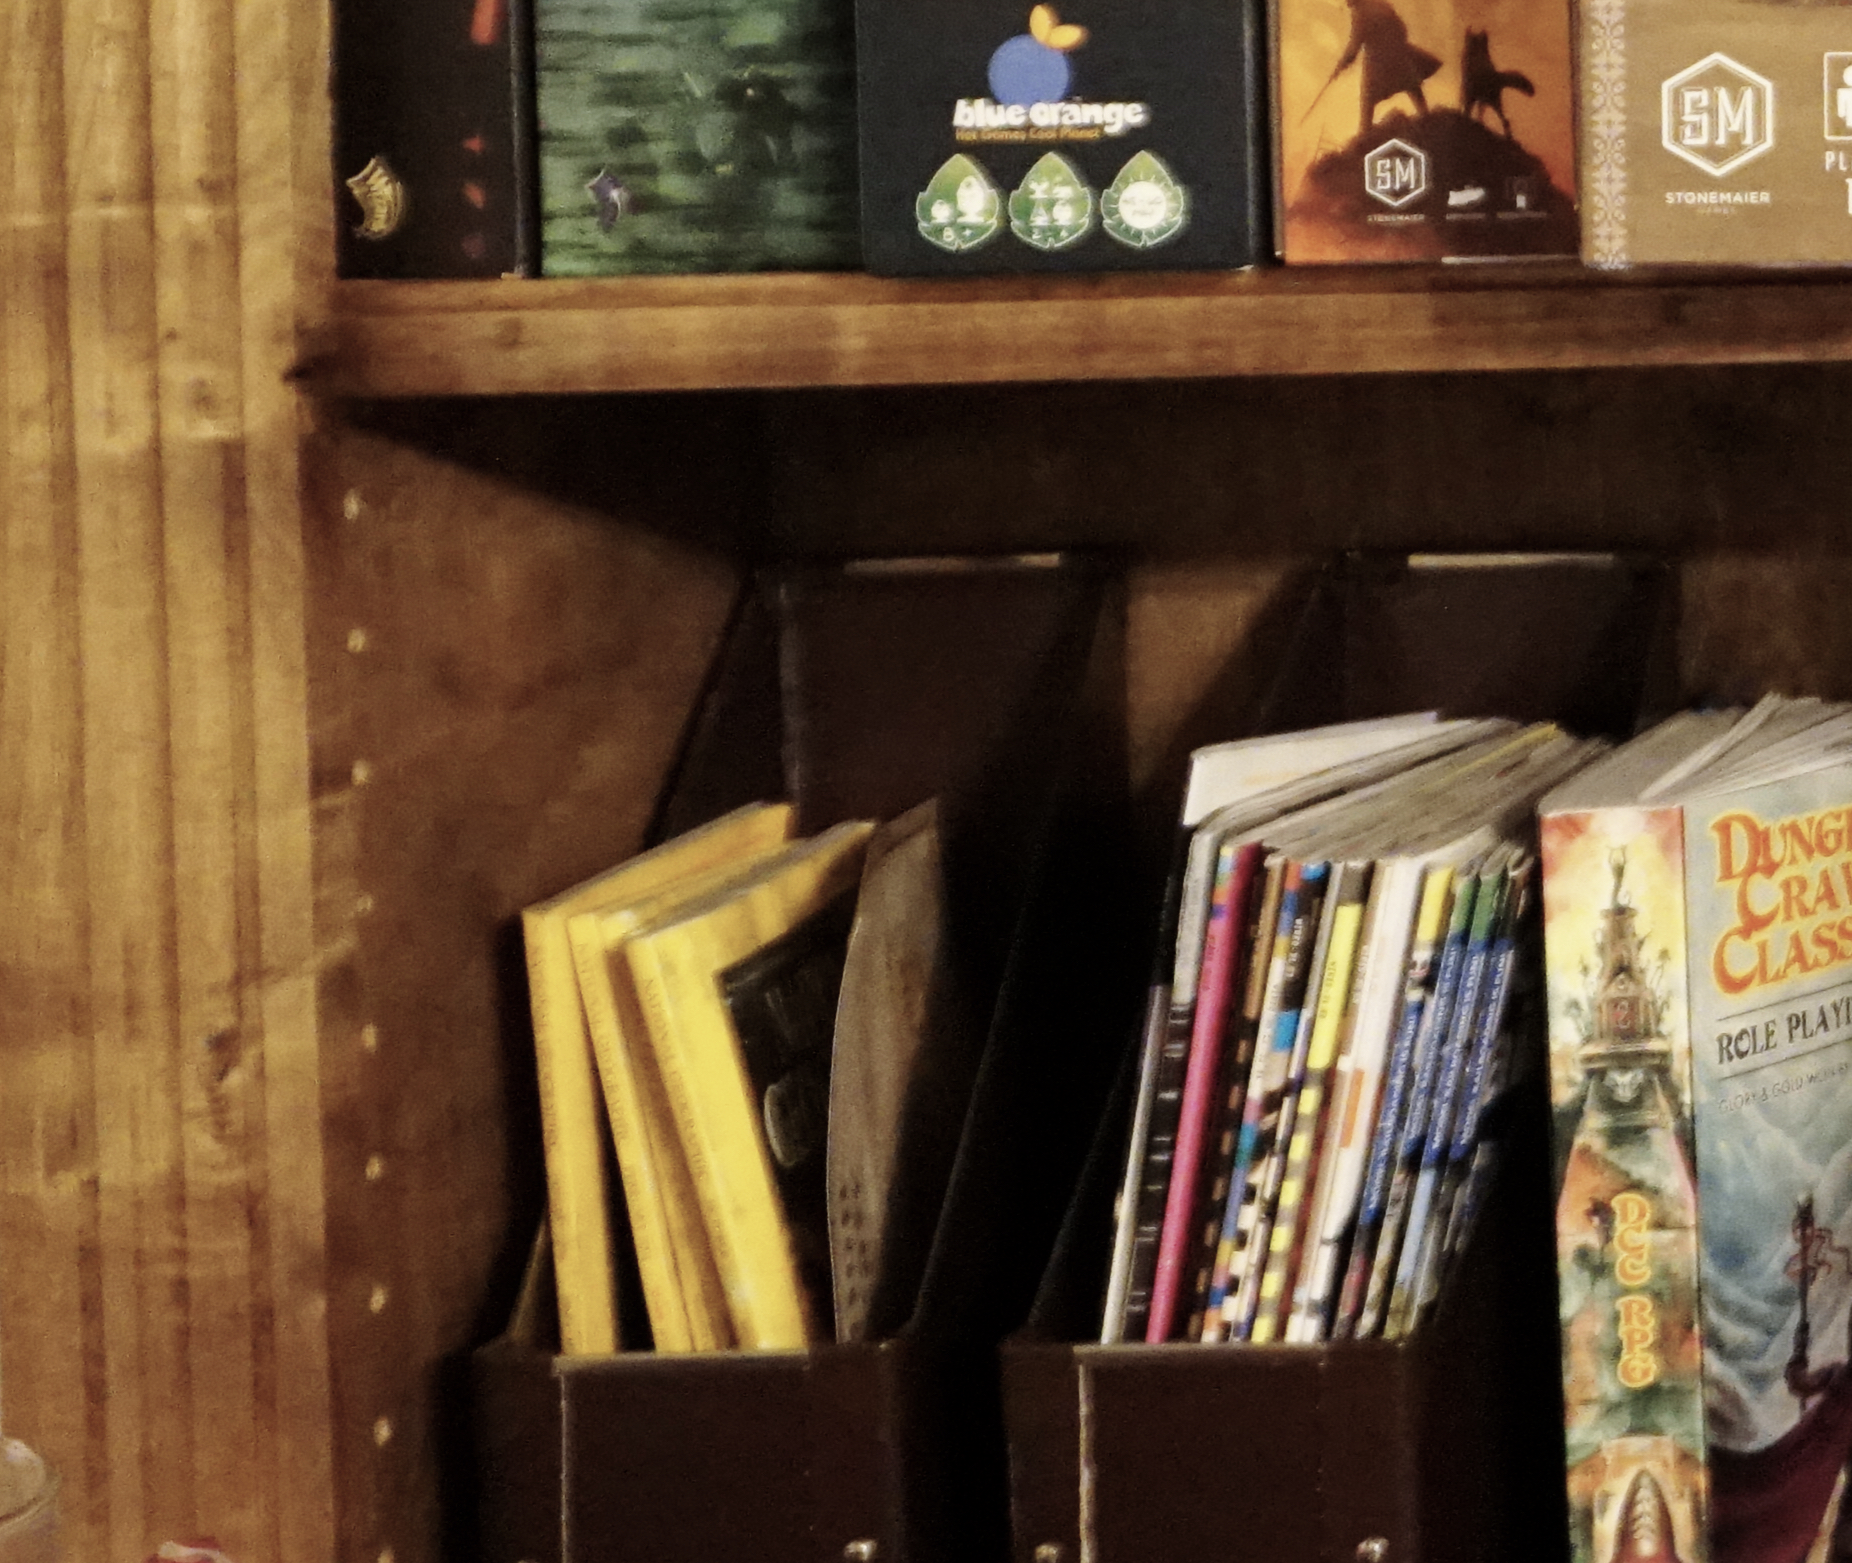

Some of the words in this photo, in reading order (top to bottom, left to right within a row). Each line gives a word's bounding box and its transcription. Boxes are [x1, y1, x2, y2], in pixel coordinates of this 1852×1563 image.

[953, 98, 1027, 128] blue
[1029, 100, 1146, 134] orange
[1680, 85, 1755, 147] SM
[1376, 156, 1416, 190] SM
[1665, 191, 1770, 204] STONEMAIER
[1717, 1017, 1778, 1066] ROLE
